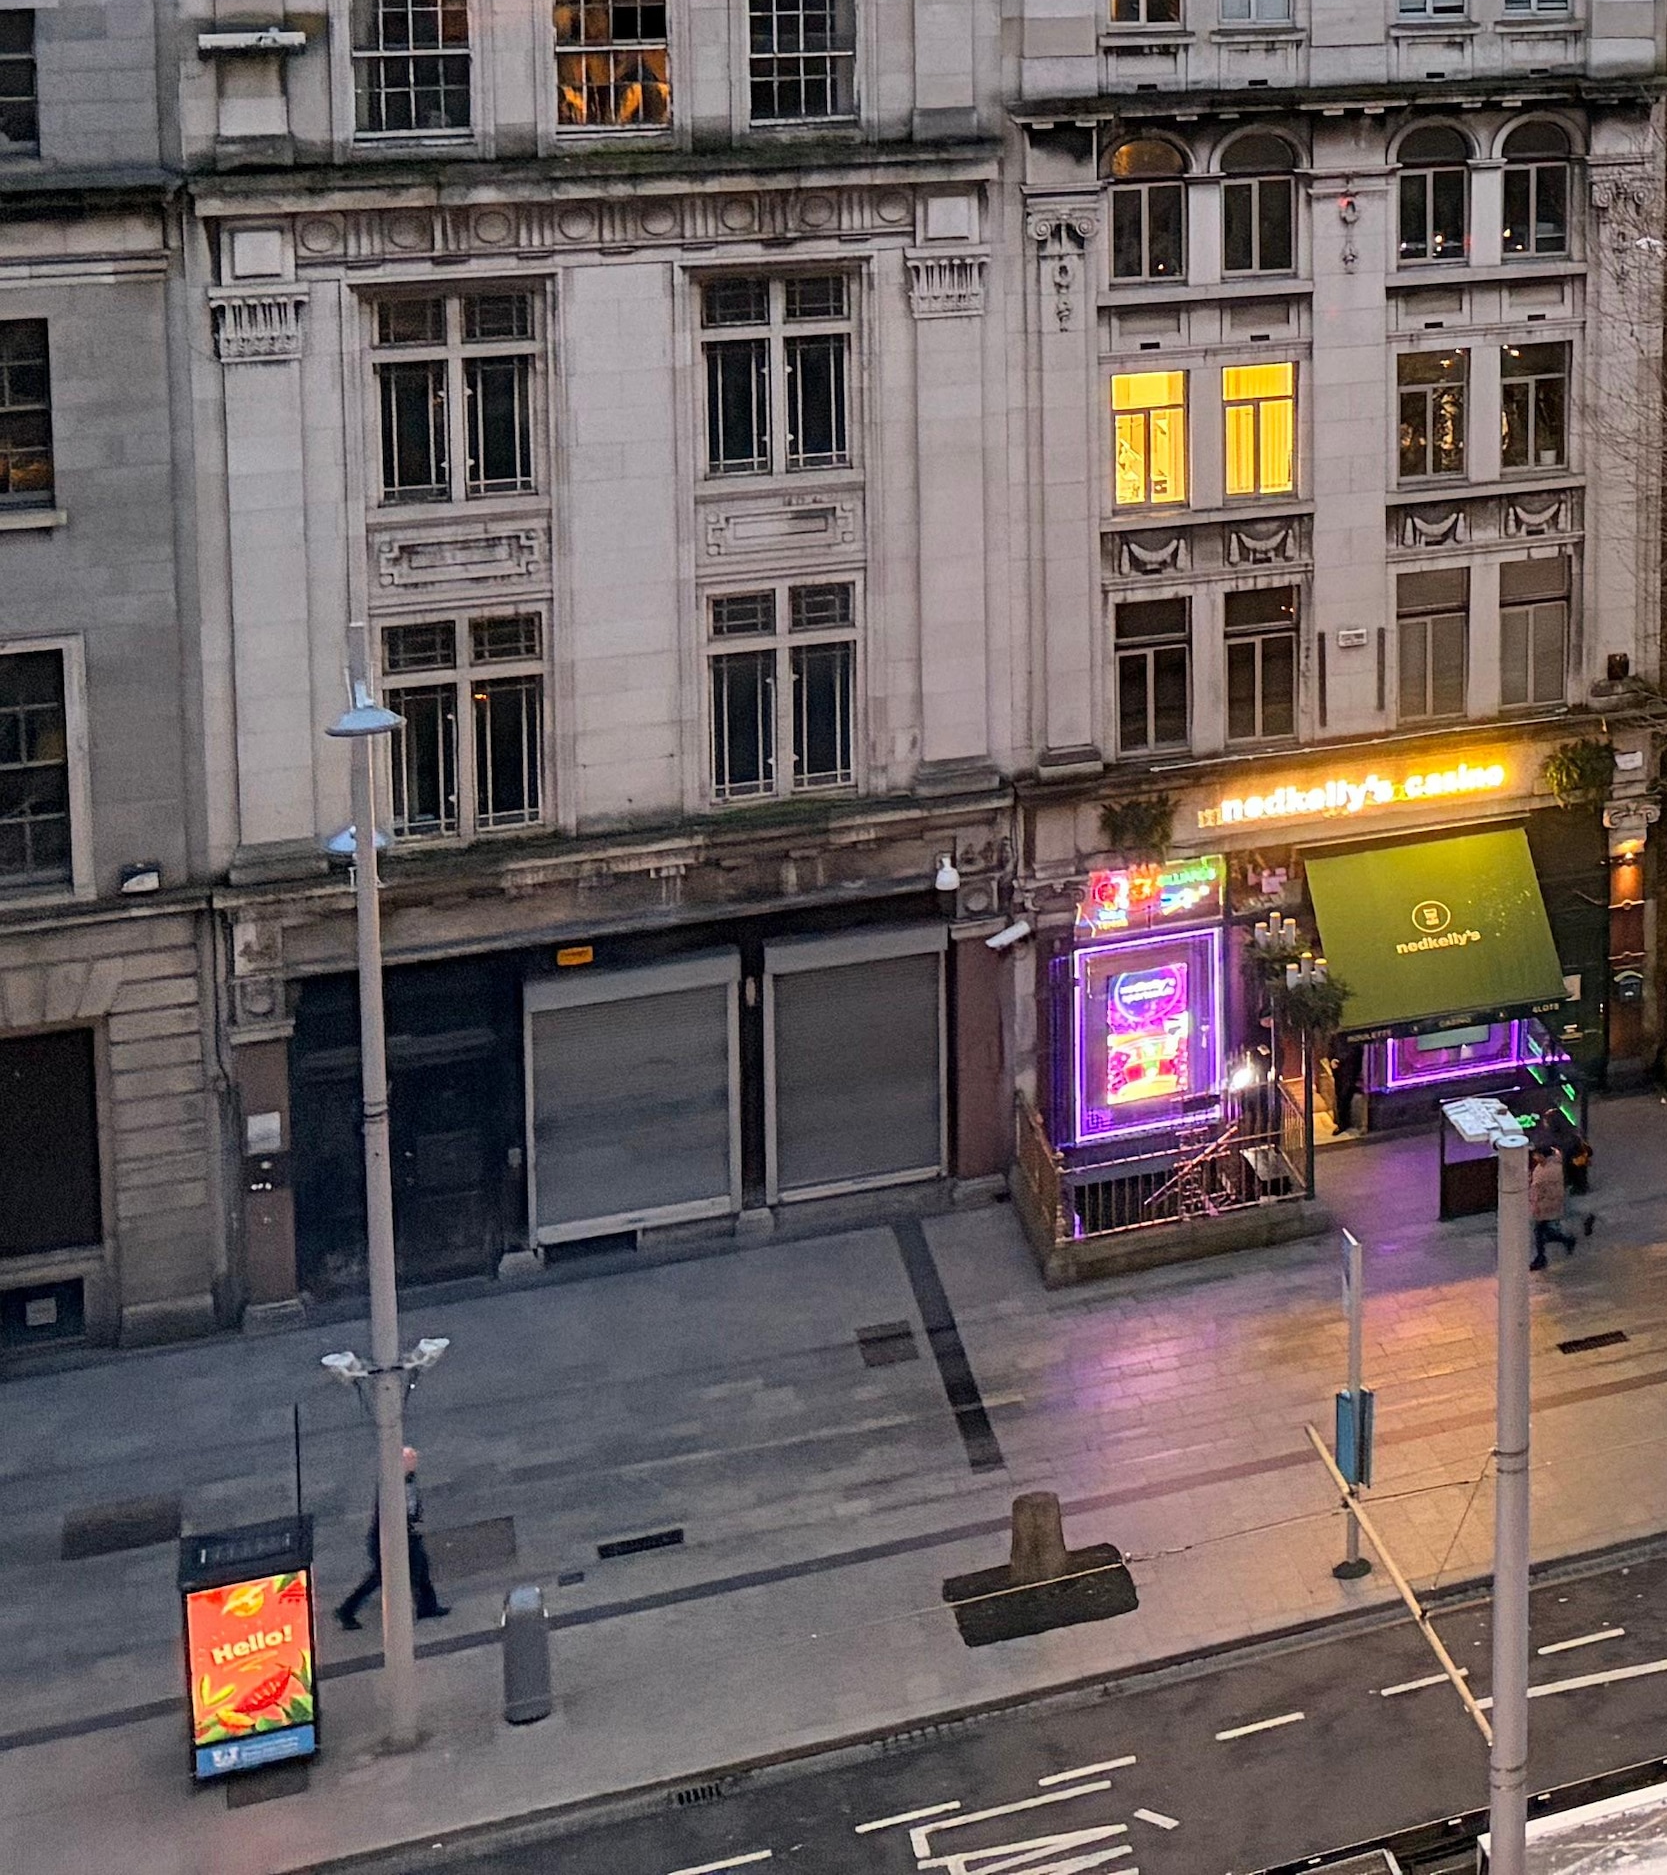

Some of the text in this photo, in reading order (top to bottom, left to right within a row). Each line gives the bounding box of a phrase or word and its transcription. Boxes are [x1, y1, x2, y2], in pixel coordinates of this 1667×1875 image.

[1221, 764, 1505, 822] nedkelly's casino
[1396, 929, 1481, 954] nedkelly's
[211, 1625, 293, 1665] Hello!
